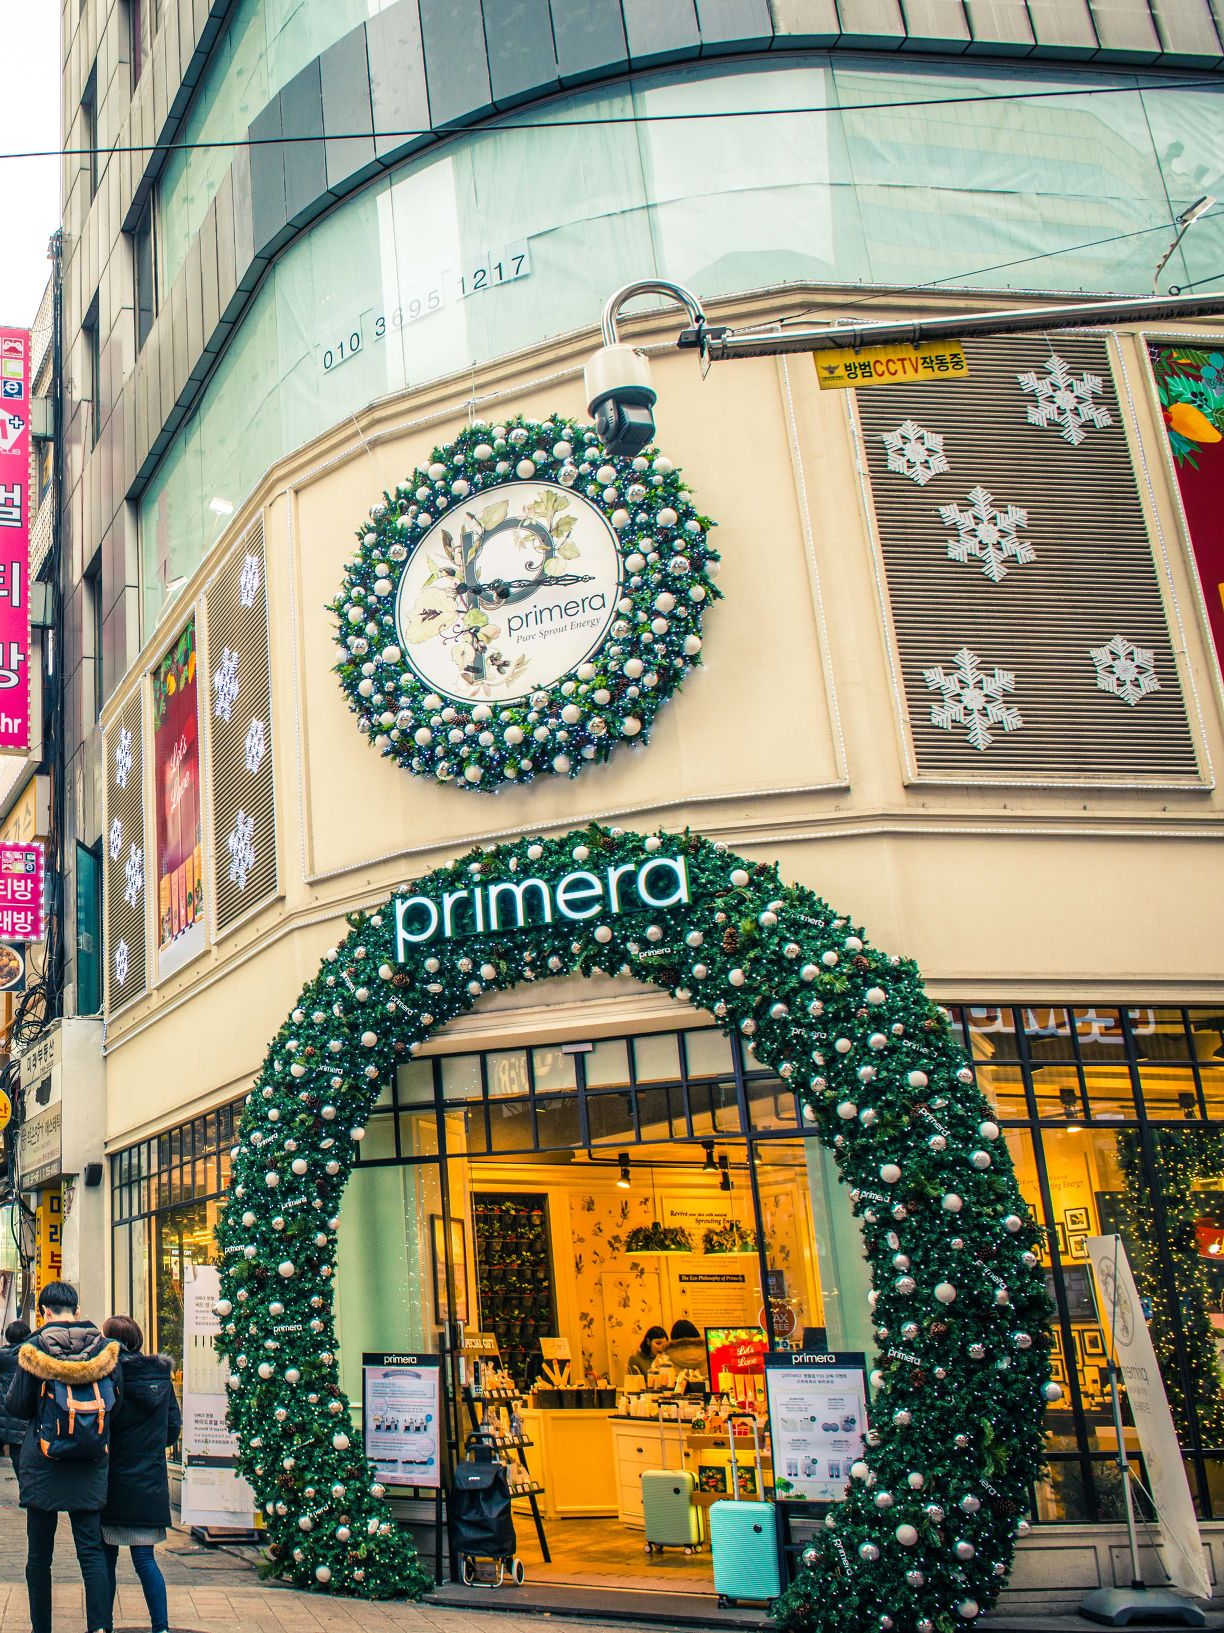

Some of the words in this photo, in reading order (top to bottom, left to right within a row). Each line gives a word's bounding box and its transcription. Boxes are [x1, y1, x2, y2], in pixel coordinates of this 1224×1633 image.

[323, 332, 361, 370] 010
[375, 288, 441, 337] 3695
[456, 254, 526, 295] 1217
[507, 592, 607, 639] primera
[516, 630, 538, 645] Pure
[538, 623, 568, 643] Sprout
[569, 614, 603, 636] Energy
[395, 855, 691, 964] primera
[638, 946, 672, 959] primera
[389, 993, 415, 1017] primera
[790, 1026, 827, 1040] priera
[918, 1106, 951, 1137] primera
[280, 1194, 308, 1210] primera
[670, 1209, 689, 1218] Revive
[695, 1217, 722, 1226] Sprouting
[273, 1322, 304, 1335] primera
[773, 1323, 790, 1331] REE
[482, 1338, 495, 1349] GIFT
[736, 1344, 755, 1357] Let's
[887, 1347, 922, 1367] primera
[383, 1354, 417, 1365] primera
[737, 1356, 758, 1368] Love
[791, 1352, 836, 1365] primera
[832, 1537, 854, 1578] primera
